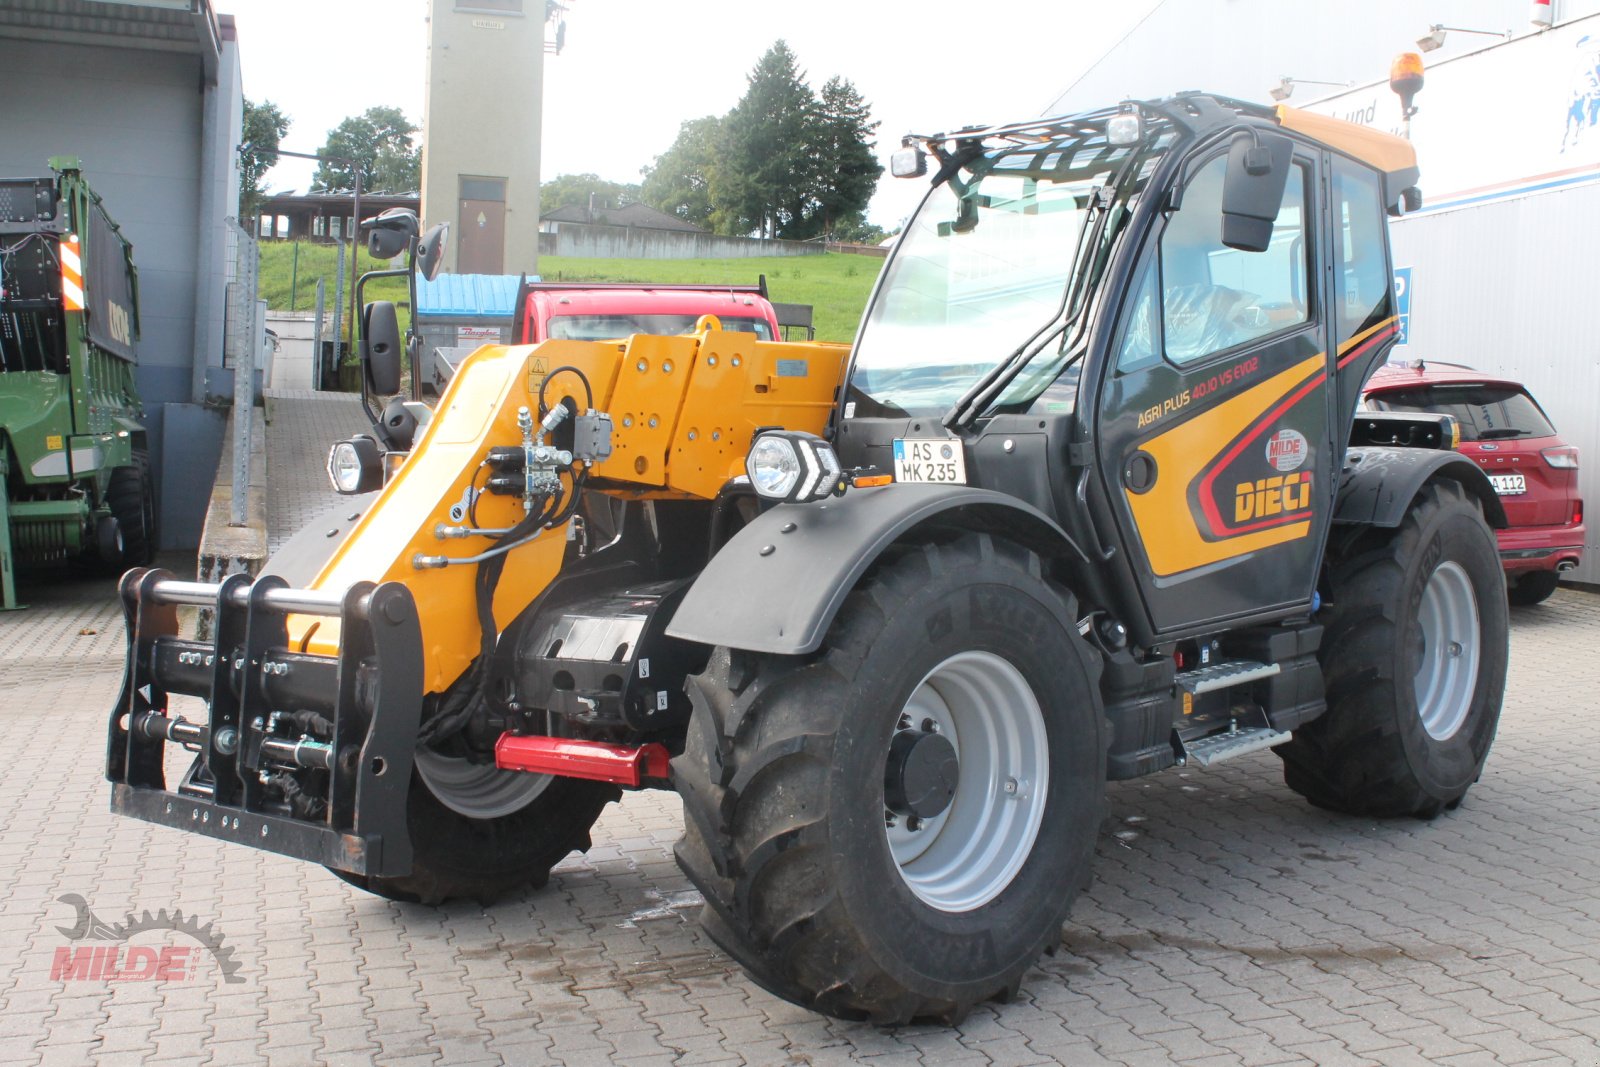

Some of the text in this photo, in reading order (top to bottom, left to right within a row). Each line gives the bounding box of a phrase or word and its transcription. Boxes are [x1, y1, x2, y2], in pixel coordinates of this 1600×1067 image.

[1137, 402, 1162, 429] AGRI
[1164, 389, 1191, 416] PLUS
[1192, 376, 1218, 399] 40.10
[1218, 369, 1233, 387] VS
[912, 442, 932, 461] AS
[1270, 438, 1301, 457] MILDE
[902, 463, 957, 481] MK 235
[1502, 476, 1524, 490] 112
